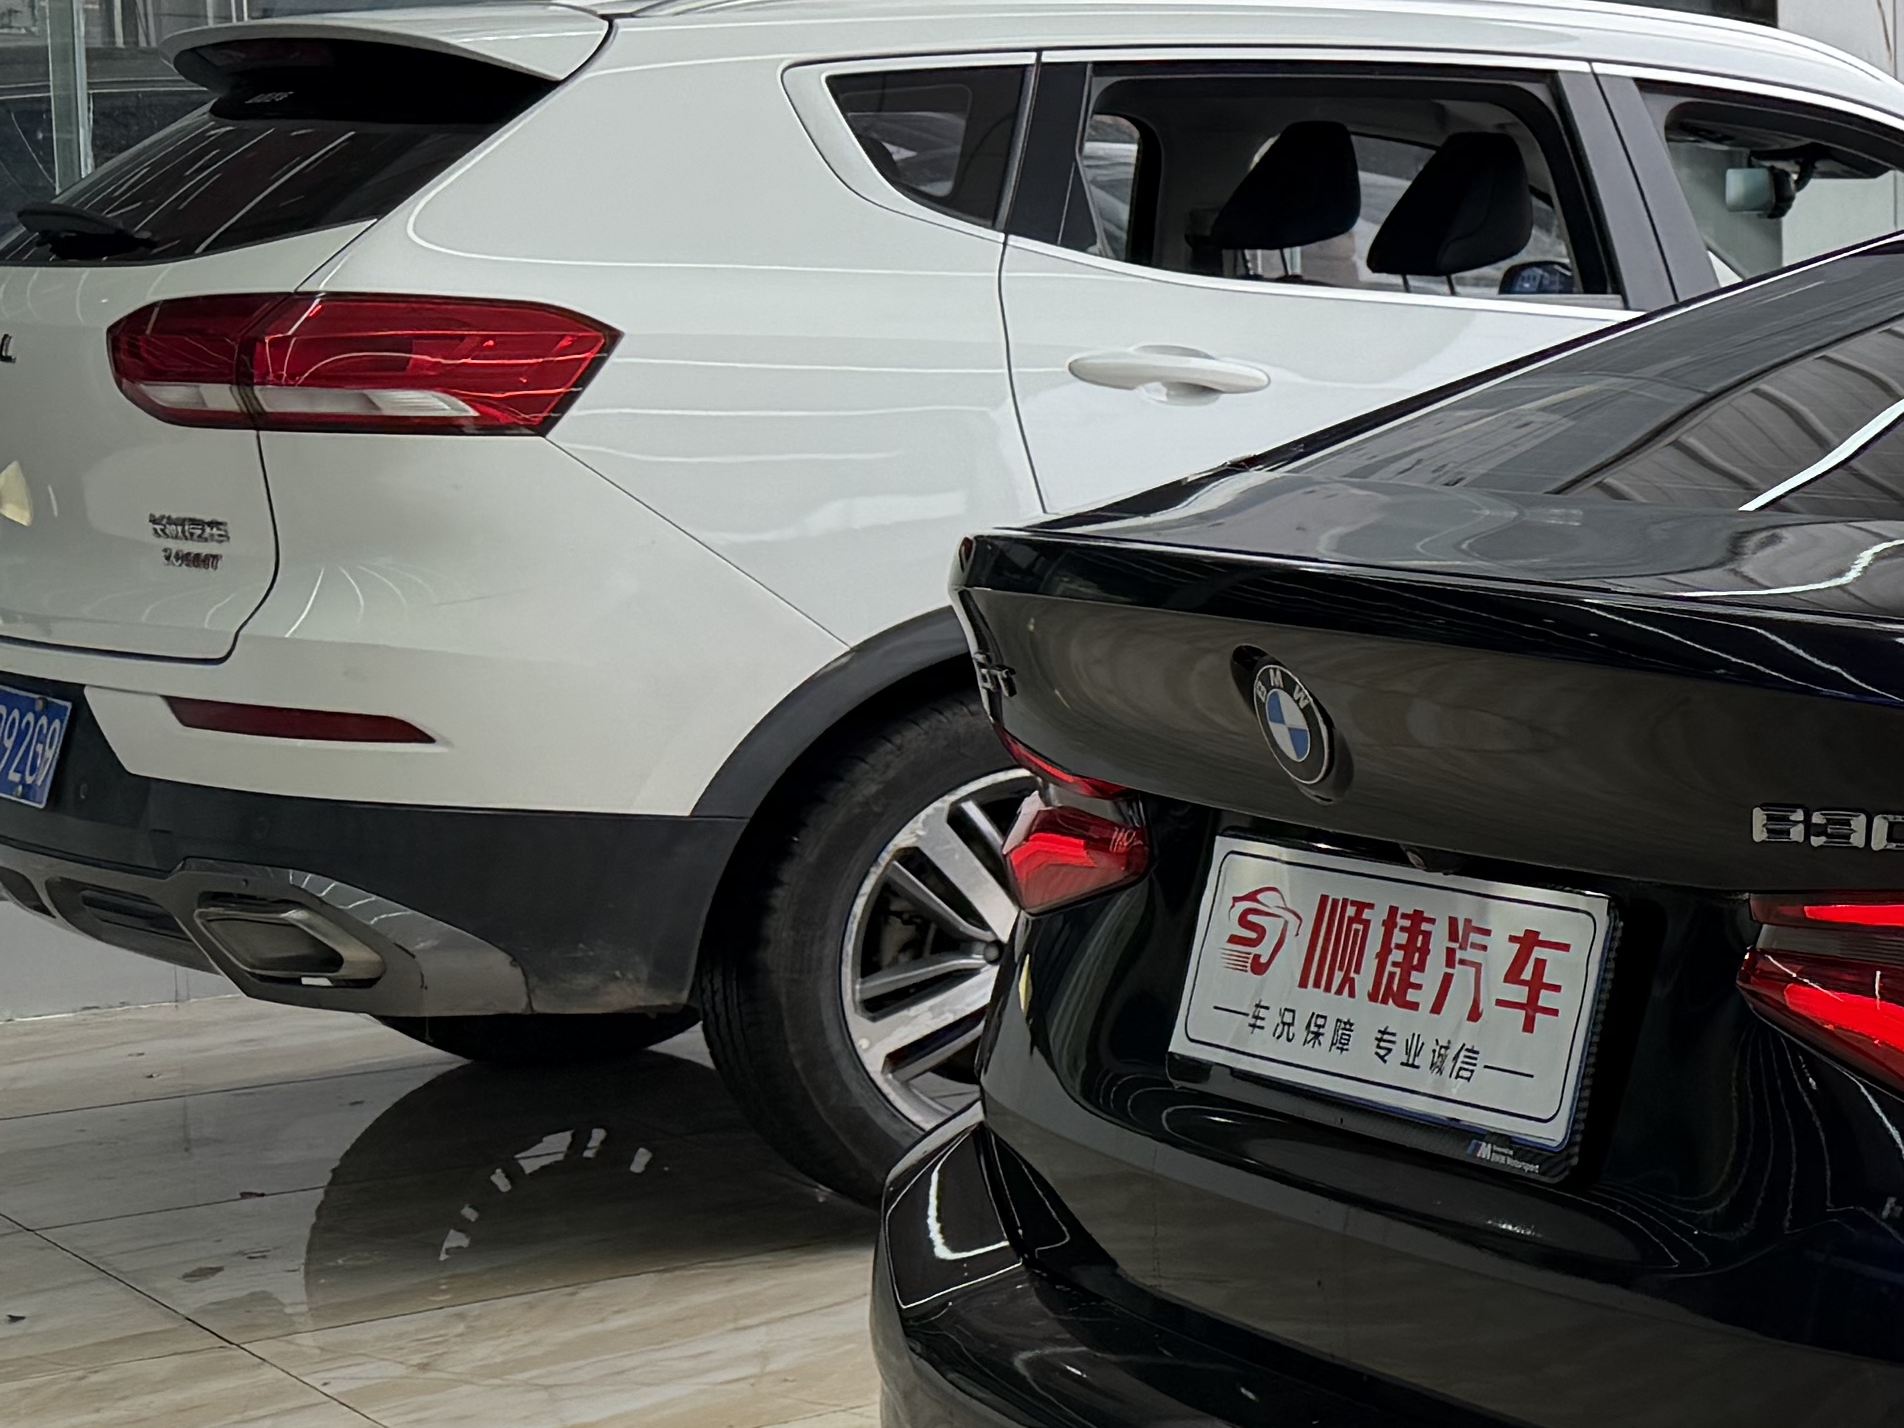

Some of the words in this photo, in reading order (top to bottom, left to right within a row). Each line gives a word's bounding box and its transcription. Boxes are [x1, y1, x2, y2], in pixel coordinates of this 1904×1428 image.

[1256, 668, 1311, 709] BMW
[1298, 893, 1572, 1035] 顺捷汽车
[1247, 998, 1356, 1057] 车况保障
[1373, 1024, 1481, 1086] 专业诚信
